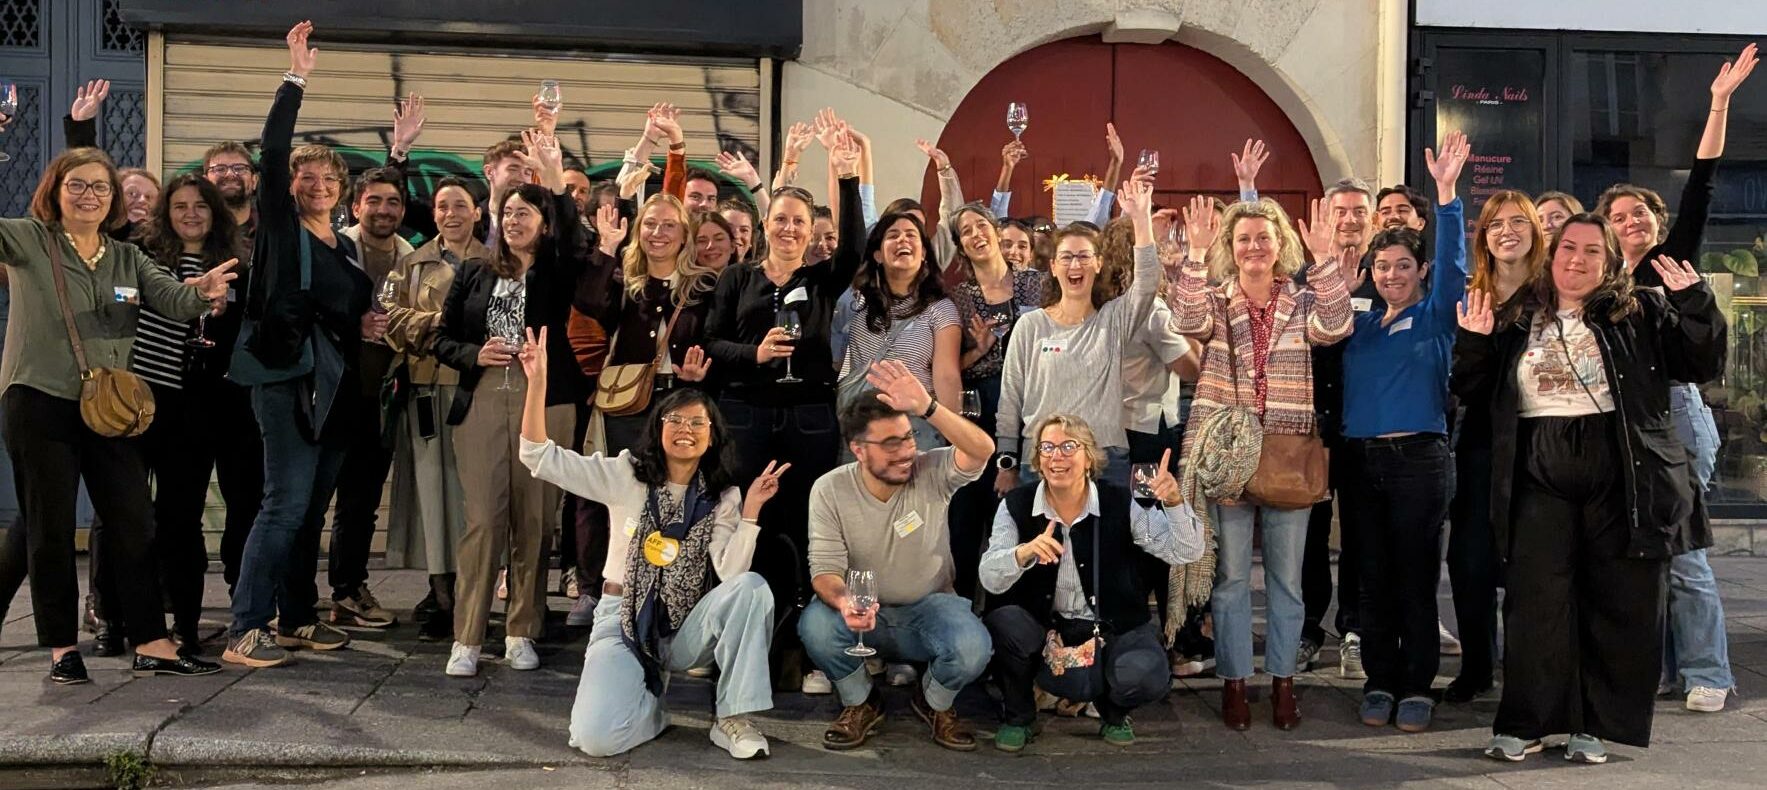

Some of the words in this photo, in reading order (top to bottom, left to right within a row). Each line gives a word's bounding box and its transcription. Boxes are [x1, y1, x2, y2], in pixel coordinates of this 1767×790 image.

[1451, 84, 1490, 100] Linda
[1494, 86, 1528, 101] Nails
[1467, 154, 1512, 163] Manucure
[1473, 175, 1489, 184] Gel
